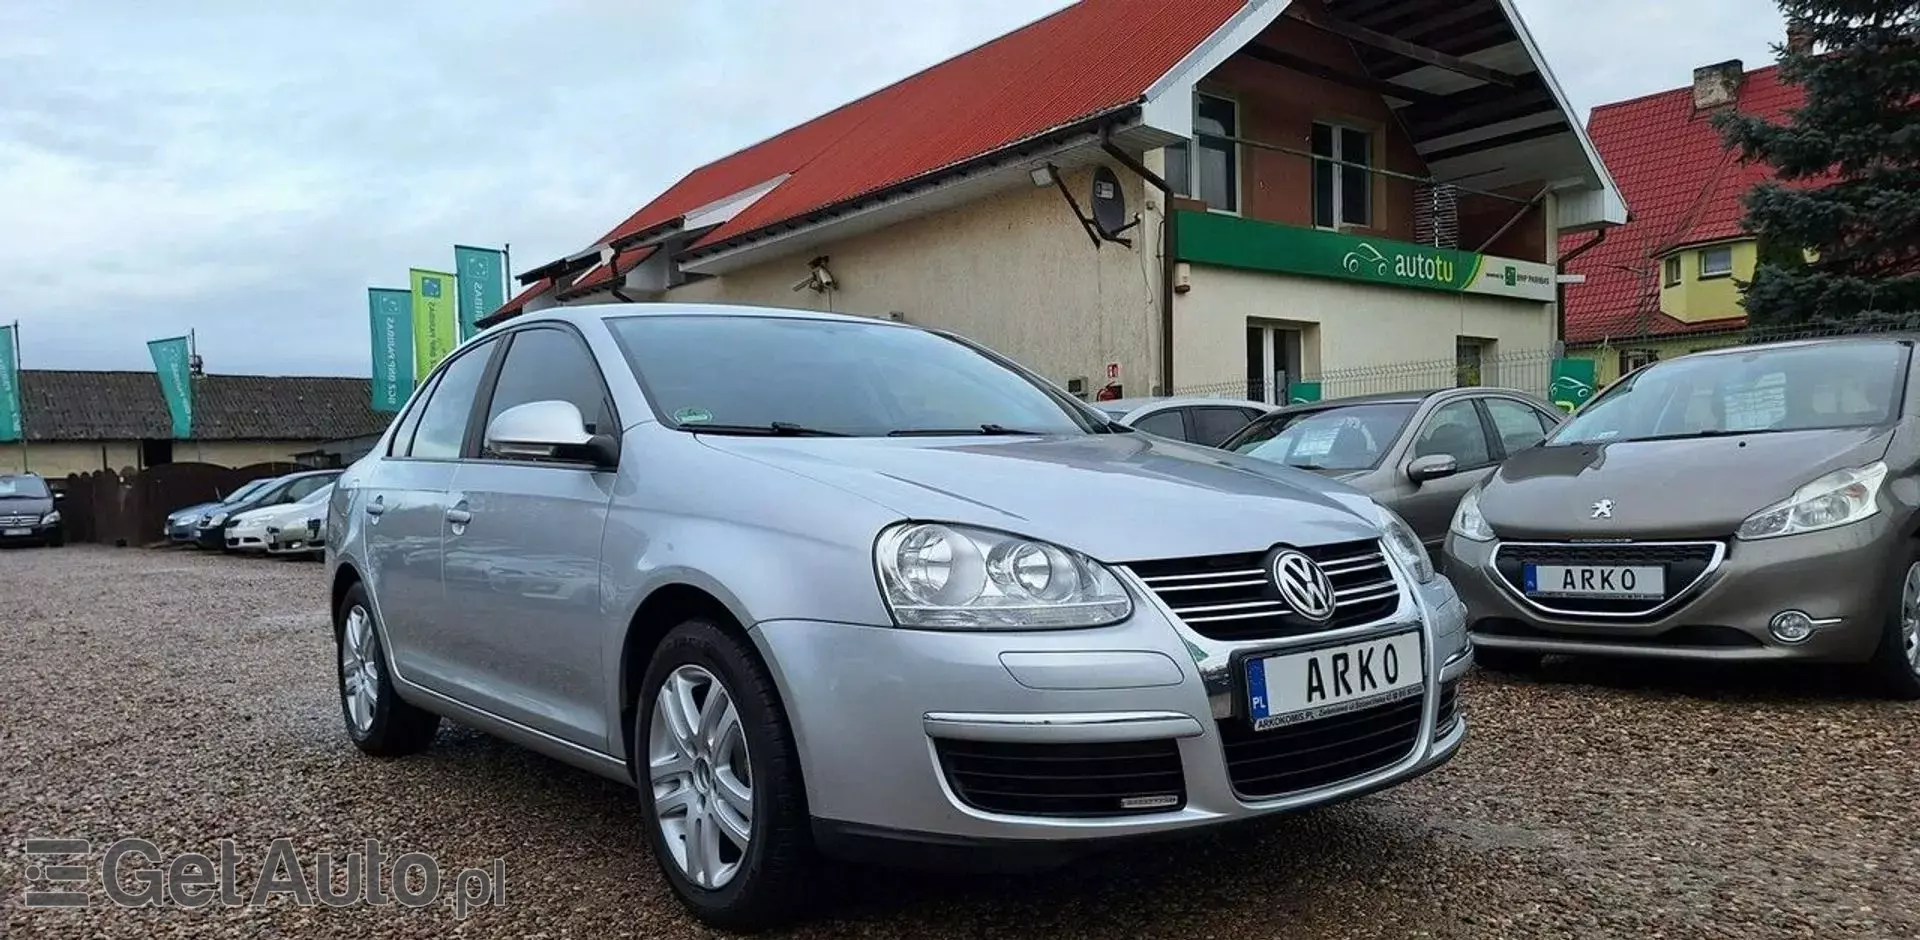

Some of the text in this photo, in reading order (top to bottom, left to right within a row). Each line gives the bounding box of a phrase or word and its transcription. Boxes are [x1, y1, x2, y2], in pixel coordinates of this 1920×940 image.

[1395, 253, 1453, 282] autotu
[1563, 568, 1636, 591] ARKO
[1307, 643, 1399, 703] ARKO
[1252, 696, 1267, 710] PL
